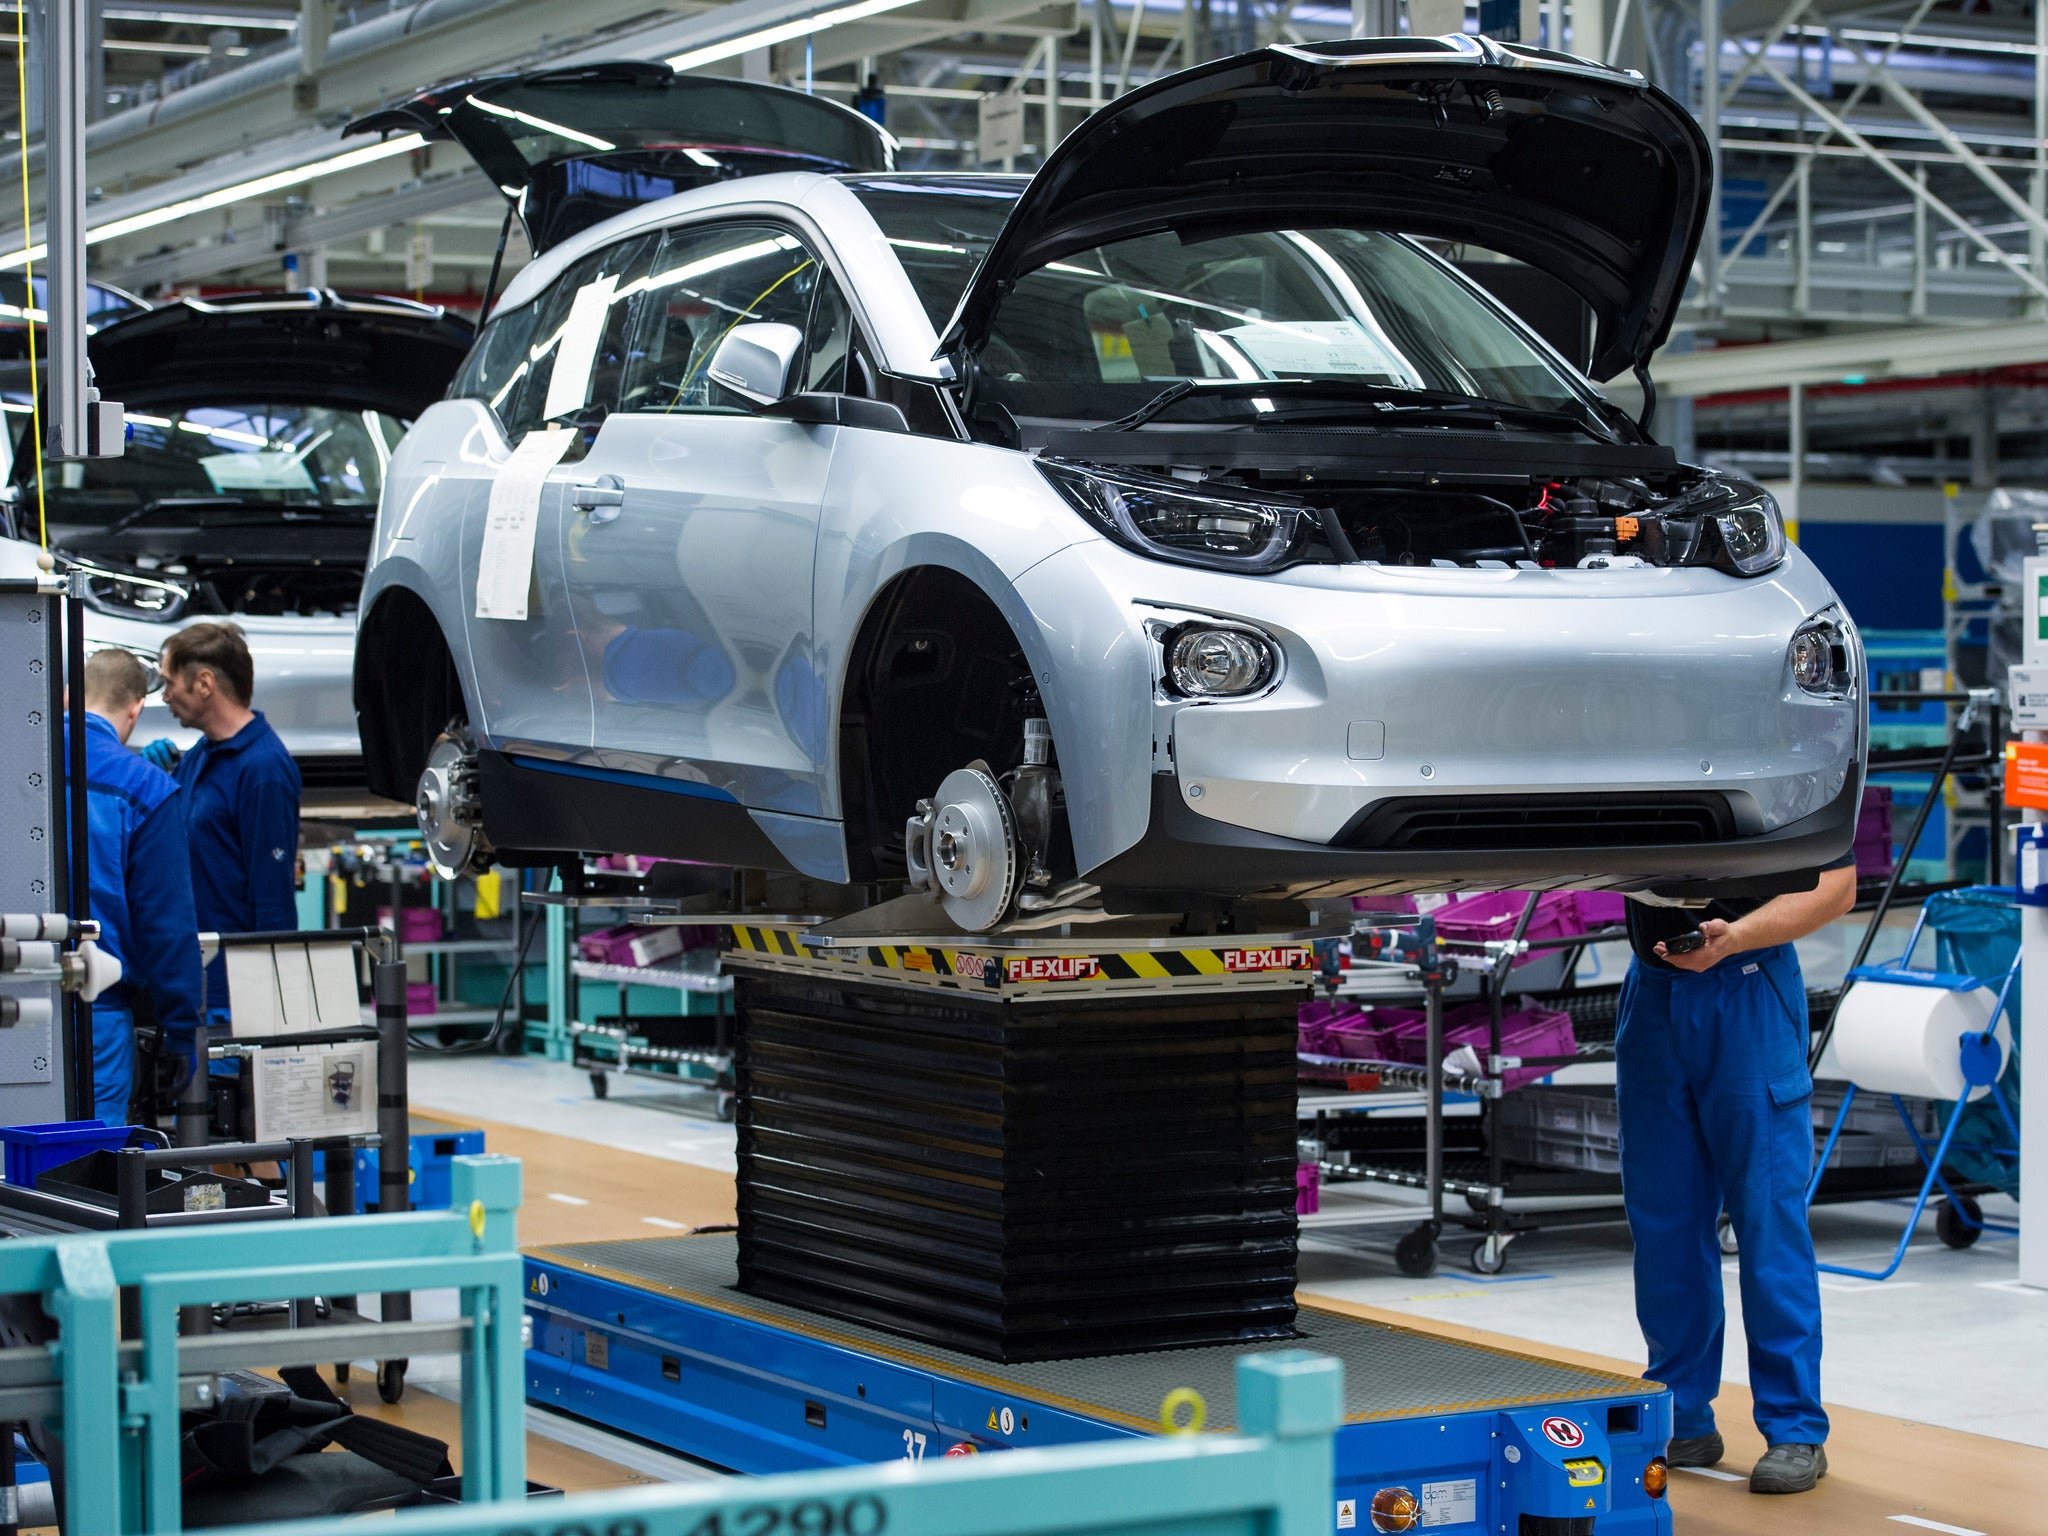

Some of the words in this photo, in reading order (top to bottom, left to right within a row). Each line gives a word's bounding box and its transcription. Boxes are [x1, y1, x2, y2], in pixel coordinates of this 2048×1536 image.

[1009, 958, 1099, 978] FLEXLIFT
[1224, 949, 1309, 968] FLEXLIFT
[903, 1429, 926, 1464] 37
